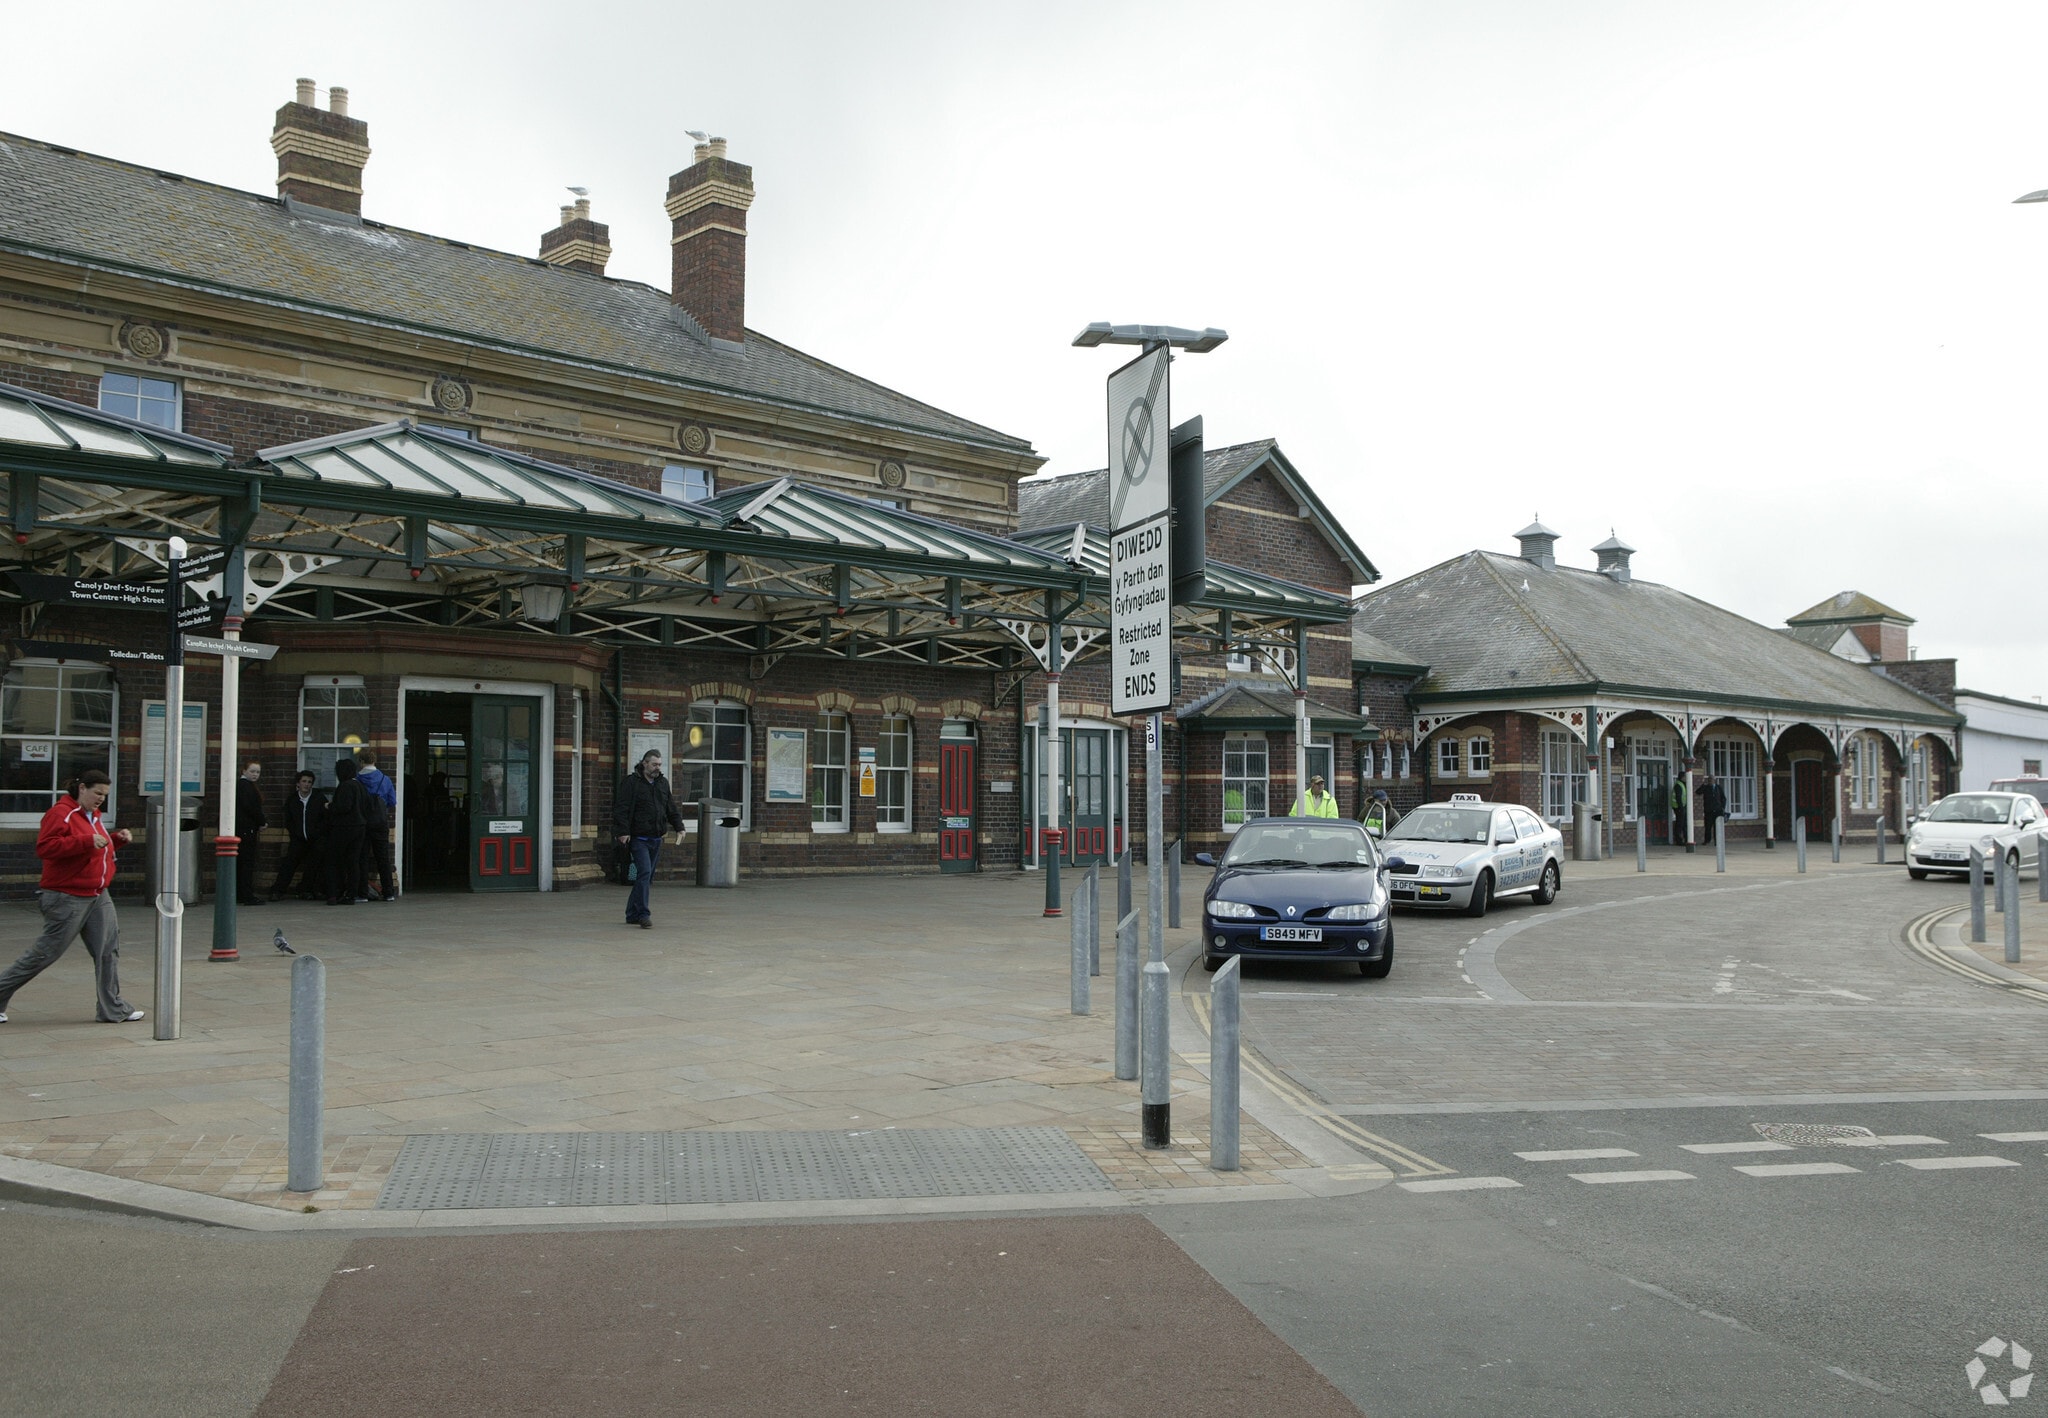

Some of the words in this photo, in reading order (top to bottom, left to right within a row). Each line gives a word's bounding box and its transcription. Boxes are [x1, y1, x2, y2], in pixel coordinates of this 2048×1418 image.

[1118, 526, 1162, 562] DIWEDD
[74, 581, 97, 589] Canol
[1116, 578, 1121, 594] y
[1124, 566, 1145, 589] Parth
[1148, 562, 1163, 580] dan
[123, 595, 140, 603] High
[1115, 586, 1165, 616] Gyfyngiadau
[1120, 618, 1162, 645] Restricted
[1130, 648, 1150, 666] Zone
[1125, 672, 1156, 698] ENDS
[25, 744, 48, 752] CAFÉ
[1268, 929, 1295, 939] S849
[1299, 929, 1319, 939] MFV
